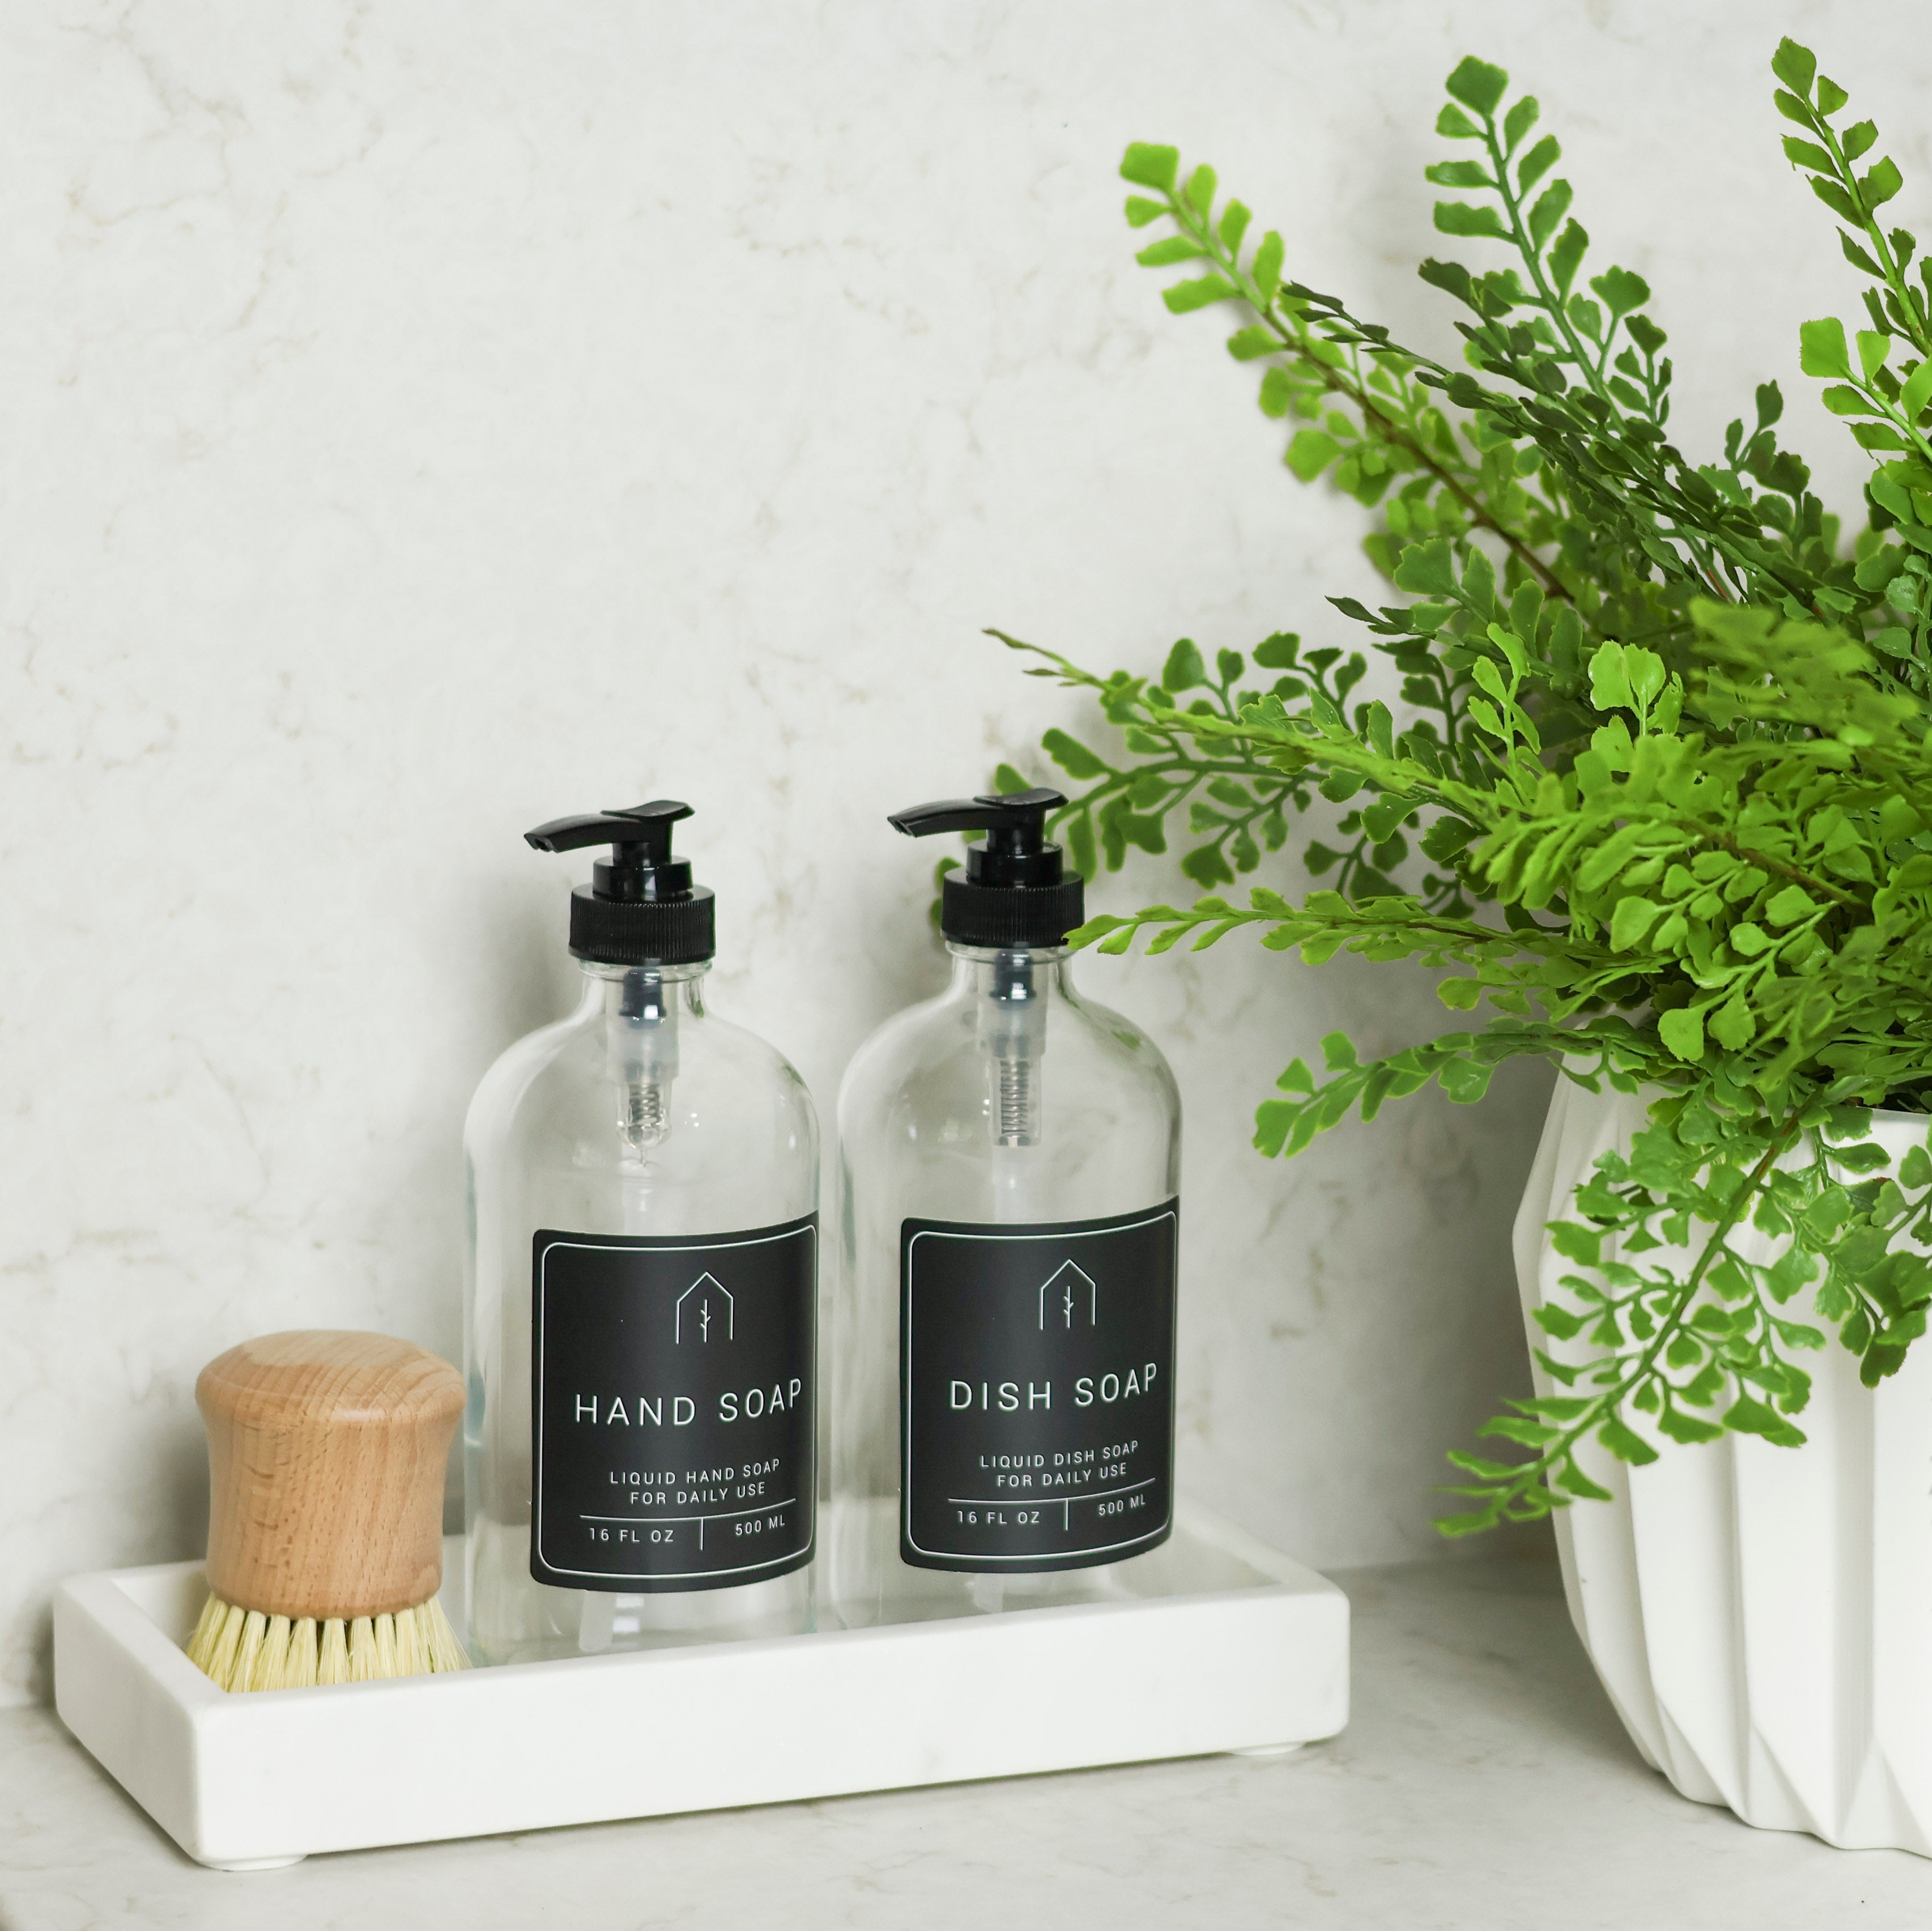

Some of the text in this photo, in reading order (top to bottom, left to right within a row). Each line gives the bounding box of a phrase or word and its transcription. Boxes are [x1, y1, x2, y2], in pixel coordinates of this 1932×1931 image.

[950, 1362, 1157, 1412] DISH SOAP
[576, 1378, 801, 1427] HAND SOAP
[979, 1440, 1138, 1469] LIQUID DISH SOAP
[610, 1458, 780, 1486] LIQUID HAND SOAP
[996, 1462, 1127, 1488] FOR DAILY USE
[630, 1481, 765, 1505] FOR DAILY USE
[1098, 1494, 1146, 1516] 500 ML
[735, 1514, 786, 1537] 500 ML
[957, 1511, 1040, 1526] 16 FL OZ
[590, 1527, 674, 1544] 16 FL OZ
